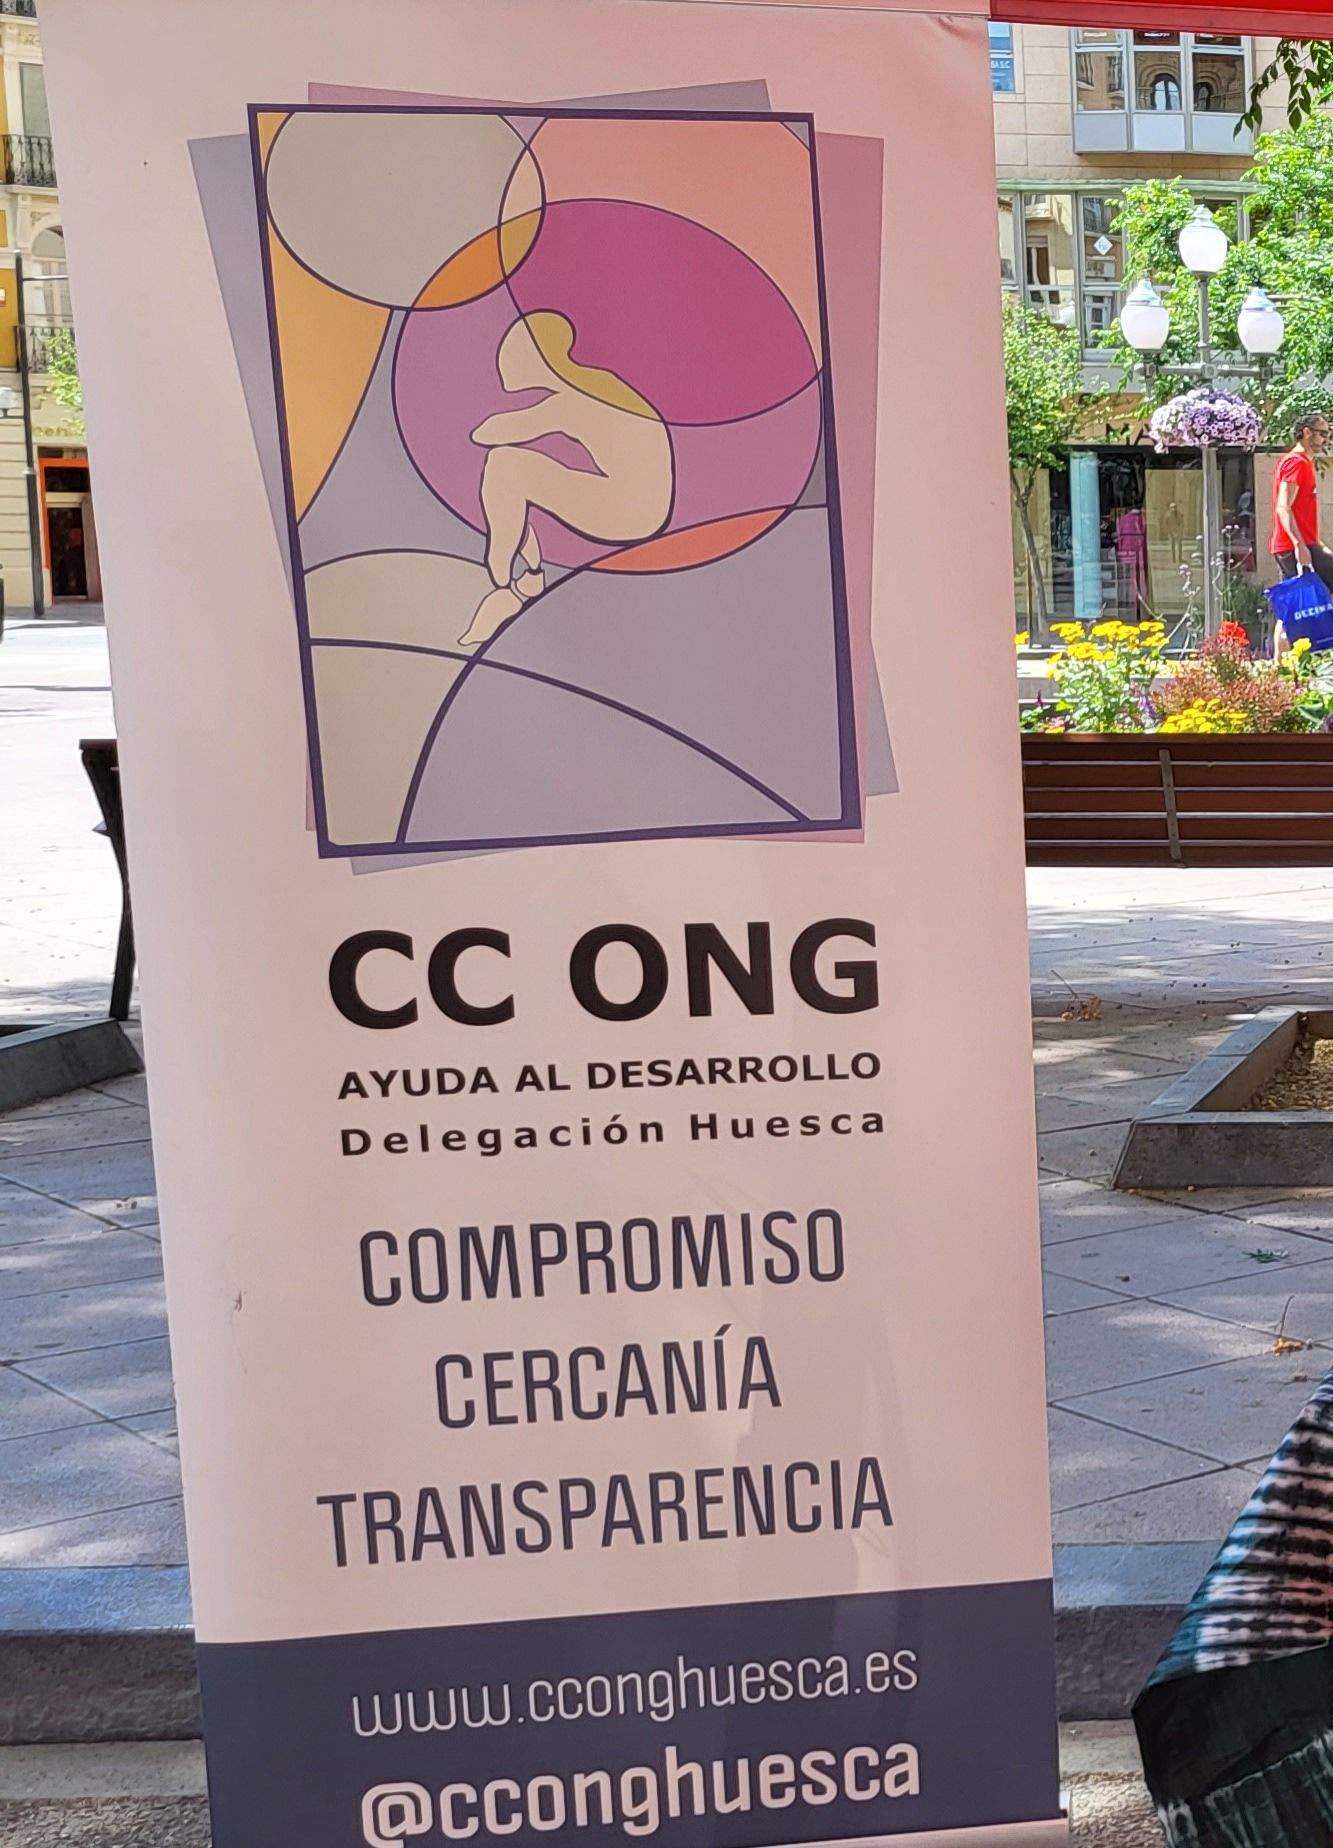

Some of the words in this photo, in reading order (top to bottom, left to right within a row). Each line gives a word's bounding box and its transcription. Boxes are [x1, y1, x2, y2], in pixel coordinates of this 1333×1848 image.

[329, 927, 515, 1030] CC
[568, 918, 880, 1022] ONG
[338, 1067, 499, 1101] AYUDA
[515, 1063, 571, 1093] AL
[587, 1051, 881, 1090] DESARROLLO
[341, 1114, 664, 1158] Delegación
[690, 1112, 884, 1141] Huesca
[359, 1208, 845, 1307] COMPROMISO
[434, 1323, 783, 1430] CERCANÍA
[316, 1456, 894, 1568] TRANSPARENCIA
[352, 1649, 918, 1737] www.cconghuesca.es
[361, 1742, 921, 1848] @cconghuesca
